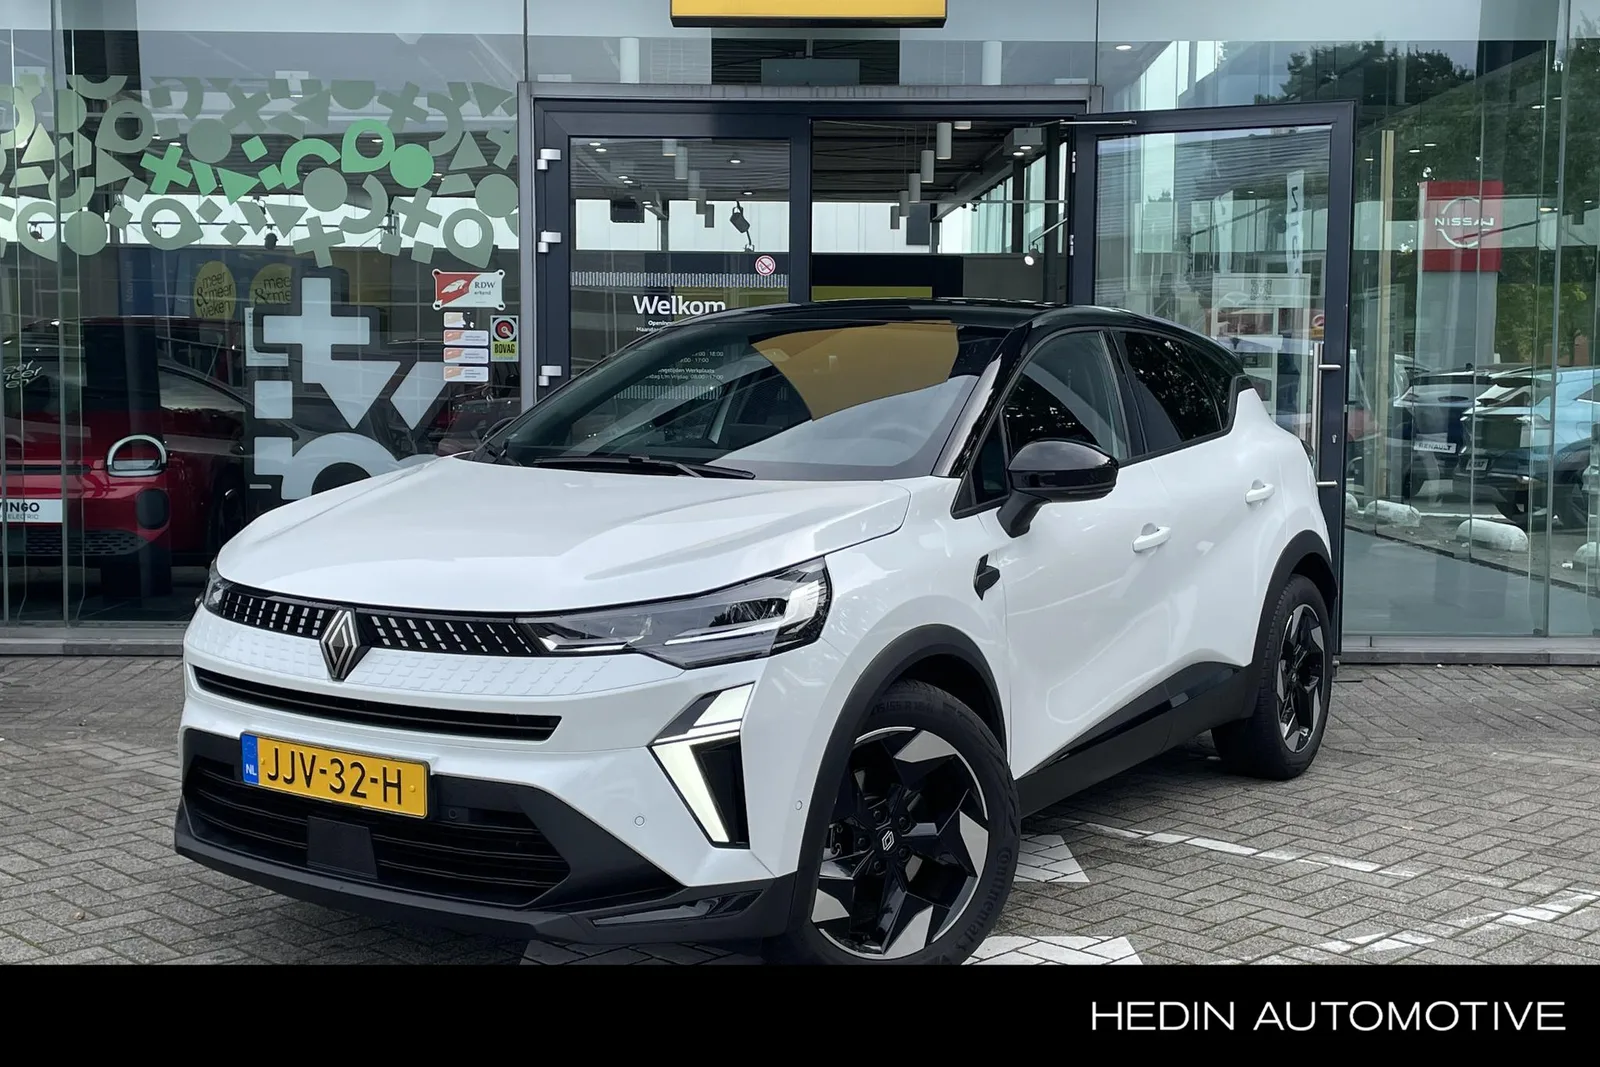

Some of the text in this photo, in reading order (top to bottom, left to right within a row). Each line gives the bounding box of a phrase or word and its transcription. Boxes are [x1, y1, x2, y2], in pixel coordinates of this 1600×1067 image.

[1434, 217, 1494, 226] NISSAN
[474, 281, 496, 289] RDW
[632, 295, 726, 315] Welkom
[494, 343, 516, 354] BOVAG
[1418, 443, 1452, 451] RENAULT
[245, 763, 257, 776] NL
[267, 747, 402, 805] JJV-32-H
